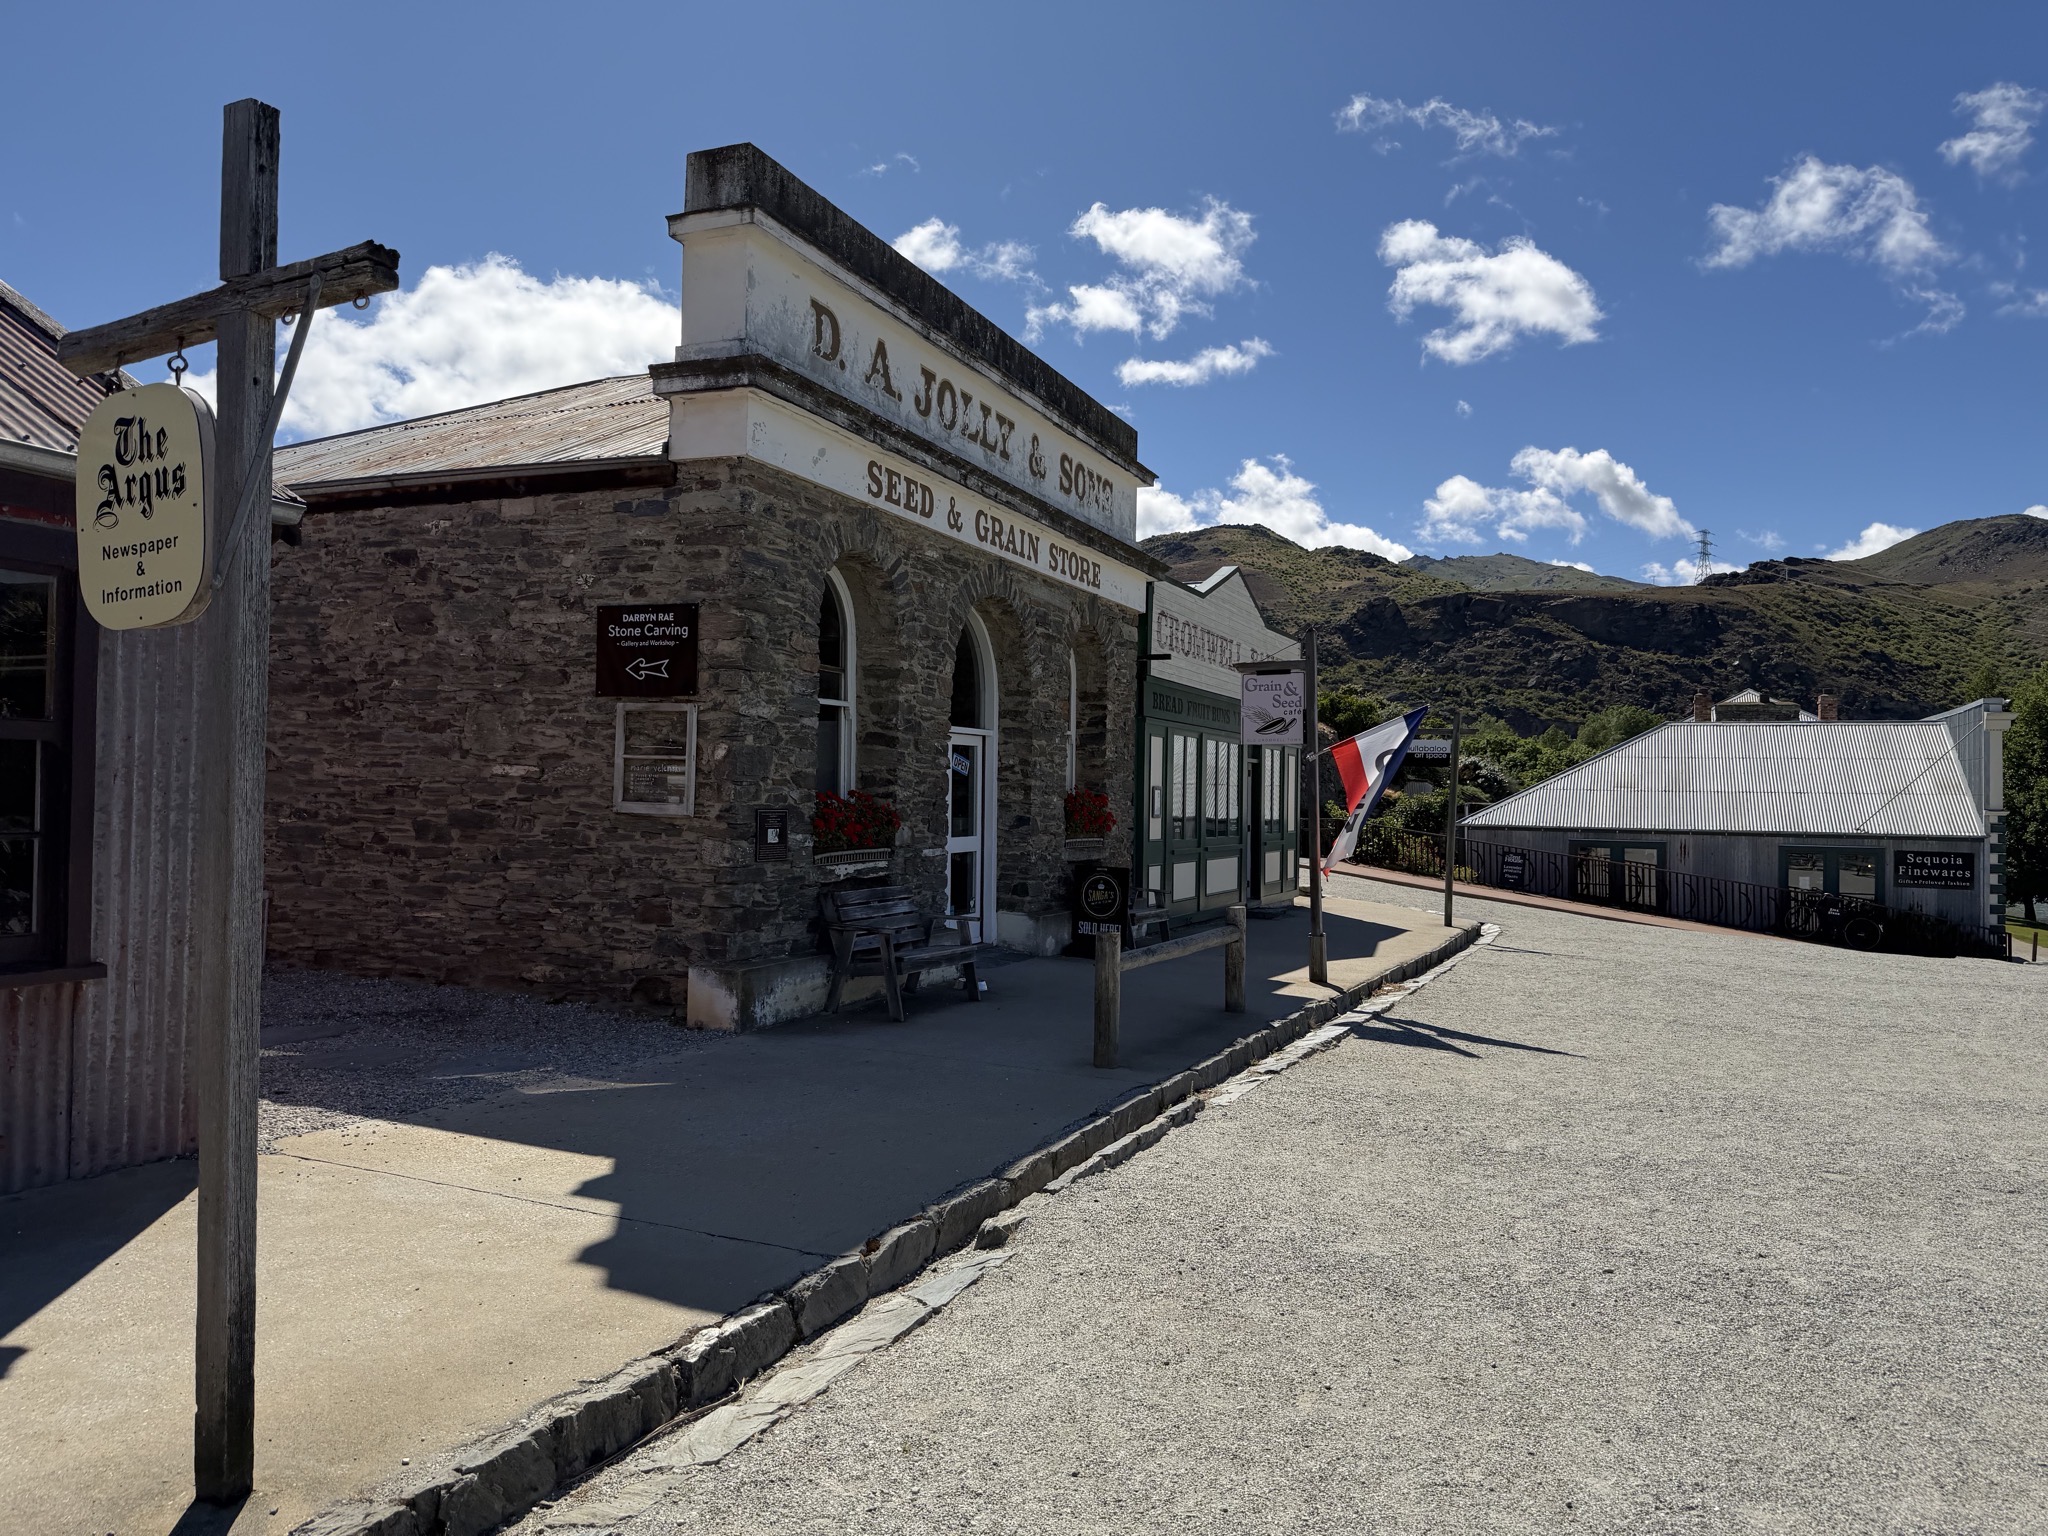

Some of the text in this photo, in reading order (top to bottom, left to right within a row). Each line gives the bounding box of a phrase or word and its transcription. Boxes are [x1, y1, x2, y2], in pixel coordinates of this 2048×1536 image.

[810, 297, 1114, 515] D. A. JOLLY & SONS
[114, 414, 169, 467] The
[93, 461, 187, 532] Argus
[867, 460, 1101, 589] SEED & GRAIN STORE
[102, 535, 178, 561] Newspaper
[136, 561, 146, 577] &
[102, 578, 182, 604] Information
[622, 612, 675, 623] DARRYN RAE
[608, 623, 689, 639] Stone Carving
[1245, 678, 1299, 696] Grain &
[1152, 691, 1183, 714] BREAD
[1187, 700, 1211, 720] FRUIT
[1212, 706, 1231, 724] BUNS
[1272, 694, 1302, 708] Seed
[953, 757, 969, 772] OPEN
[1906, 853, 1963, 866] Sequoia
[1898, 865, 1971, 878] Finewares
[1078, 921, 1098, 935] SOLD
